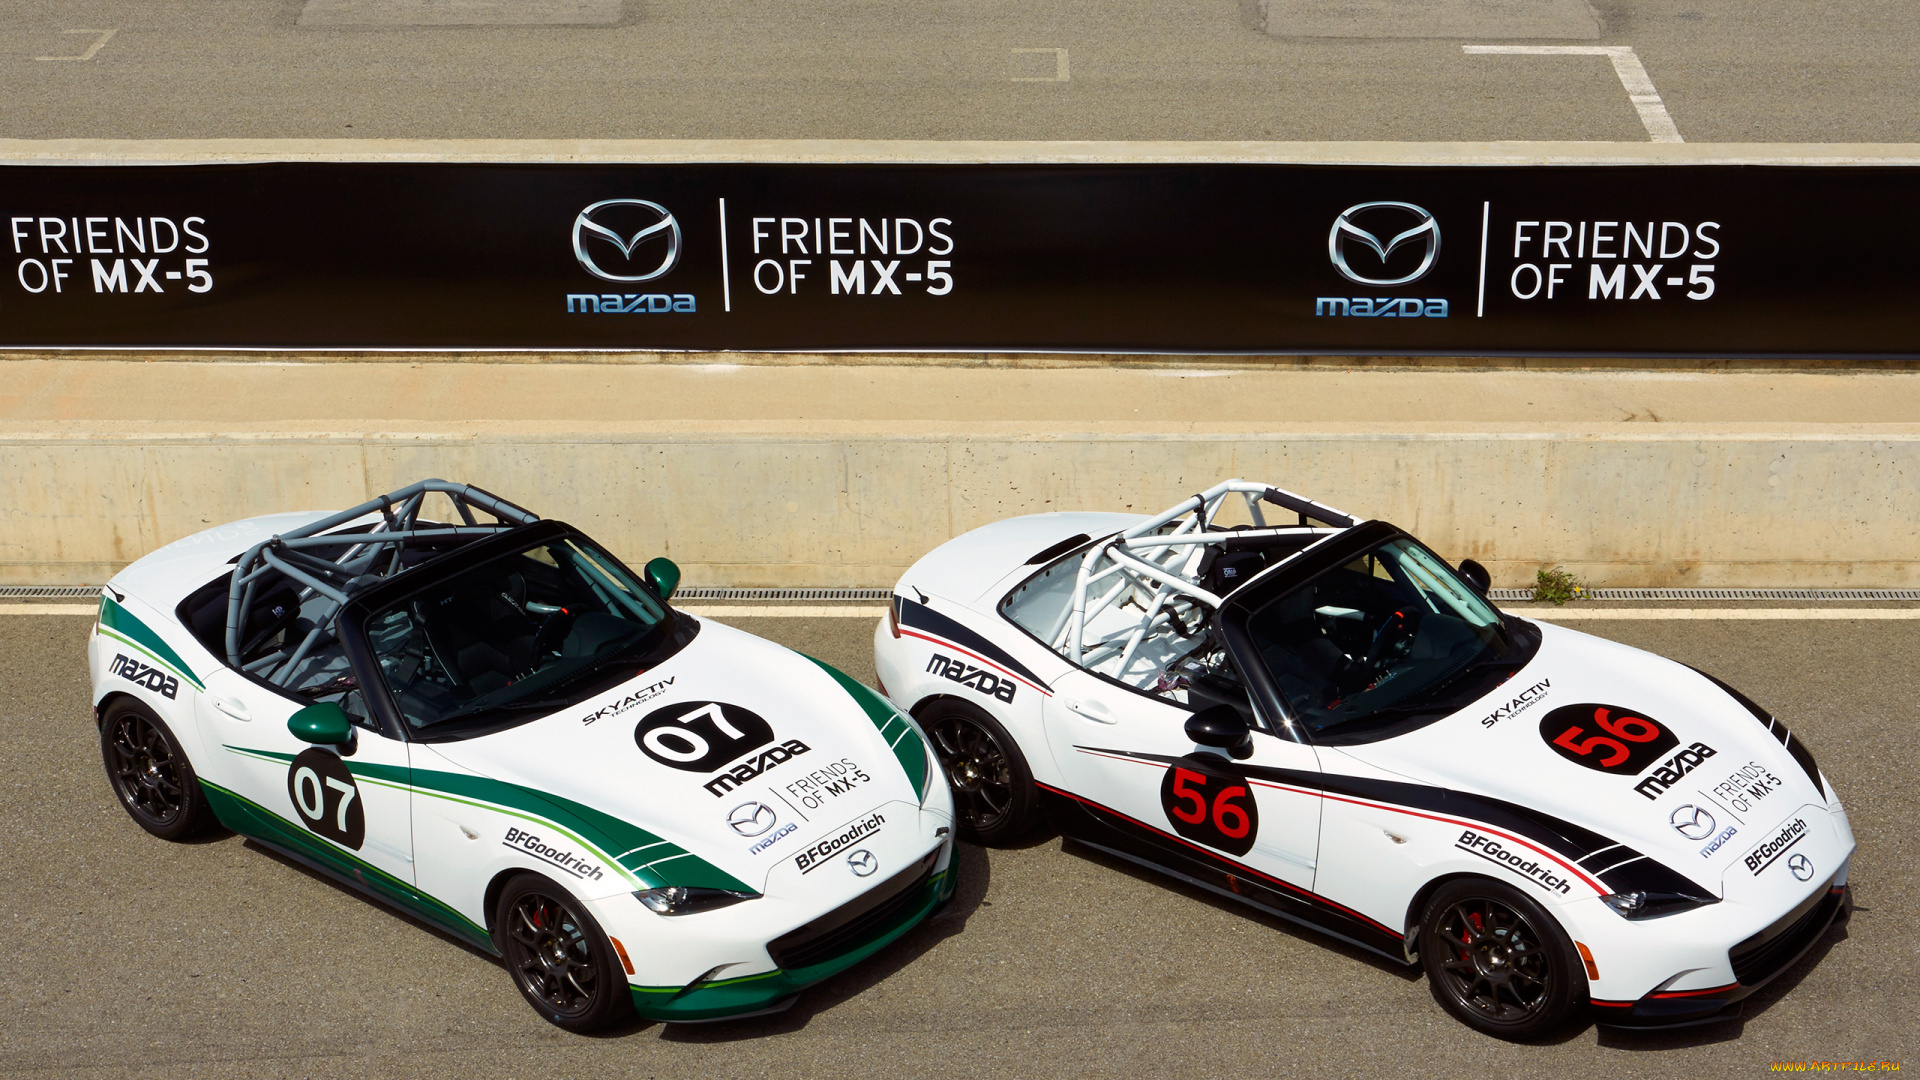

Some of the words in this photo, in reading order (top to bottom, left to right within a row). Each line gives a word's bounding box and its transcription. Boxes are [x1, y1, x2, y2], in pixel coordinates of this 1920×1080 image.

[11, 216, 210, 254] FRIENDS
[752, 217, 954, 255] FRIENDS
[1514, 221, 1721, 260] FRIENDS
[18, 258, 74, 294] OF
[91, 258, 214, 294] MX-5
[754, 258, 812, 295] OF
[830, 259, 954, 296] MX-5
[1510, 263, 1573, 300] OF
[1588, 263, 1716, 301] MX-5
[582, 676, 675, 726] SKYACTIV
[610, 689, 666, 717] TECHNOLOGY
[1481, 678, 1551, 729] SKYACTIV
[1506, 691, 1549, 720] TECHNOLOGY
[643, 702, 746, 763] 07
[1552, 707, 1660, 768] 56
[786, 758, 858, 797] FRIENDS
[802, 790, 825, 809] OF
[825, 770, 871, 797] MX-5
[1713, 761, 1766, 800] FRIENDS
[1731, 793, 1752, 812] OF
[1747, 773, 1782, 800] MX-5
[294, 766, 355, 833] 07
[1172, 767, 1250, 839] 56
[504, 826, 604, 881] BFGoodrich
[794, 813, 886, 871] BFGoodrich
[1744, 818, 1807, 871] BFGoodrich
[1458, 830, 1571, 894] BFGoodrich
